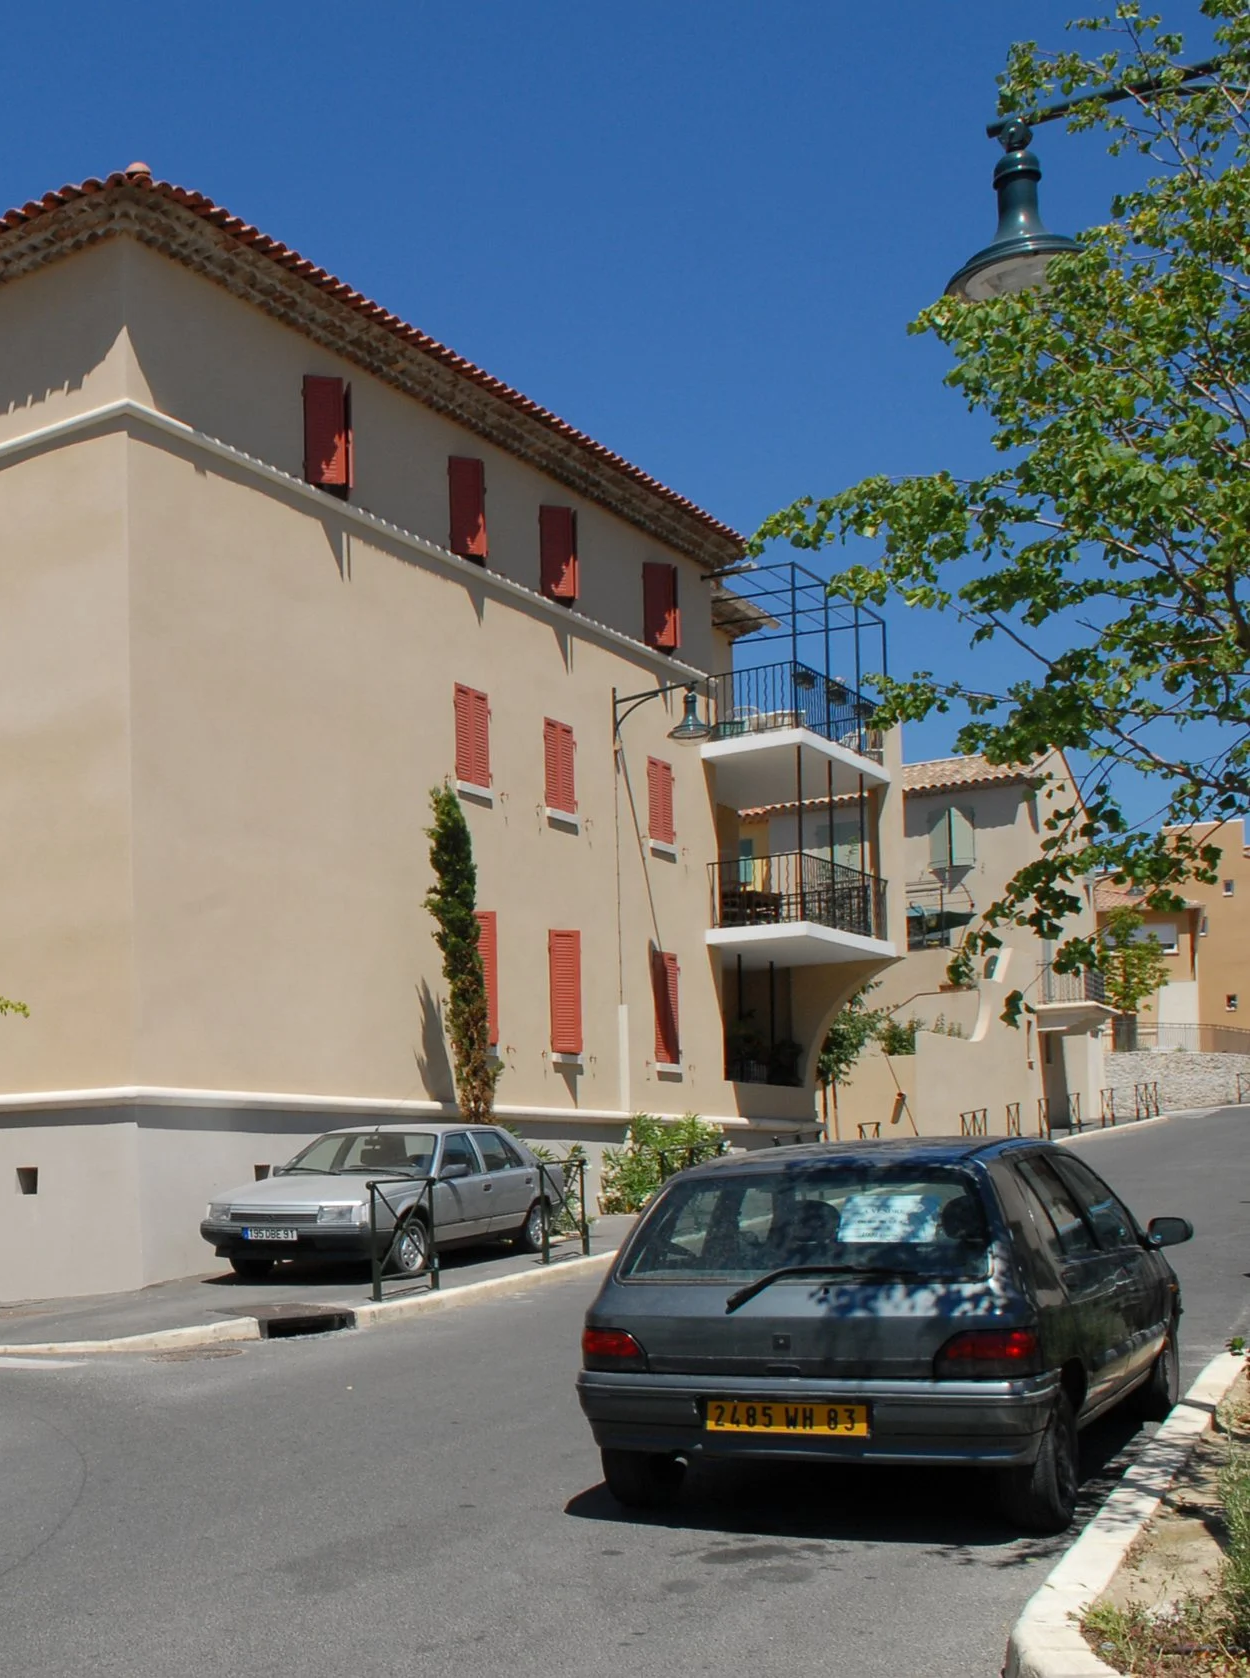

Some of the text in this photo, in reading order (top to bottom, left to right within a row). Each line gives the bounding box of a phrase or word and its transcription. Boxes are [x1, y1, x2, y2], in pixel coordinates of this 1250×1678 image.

[714, 1404, 856, 1431] 2485 WH 83
